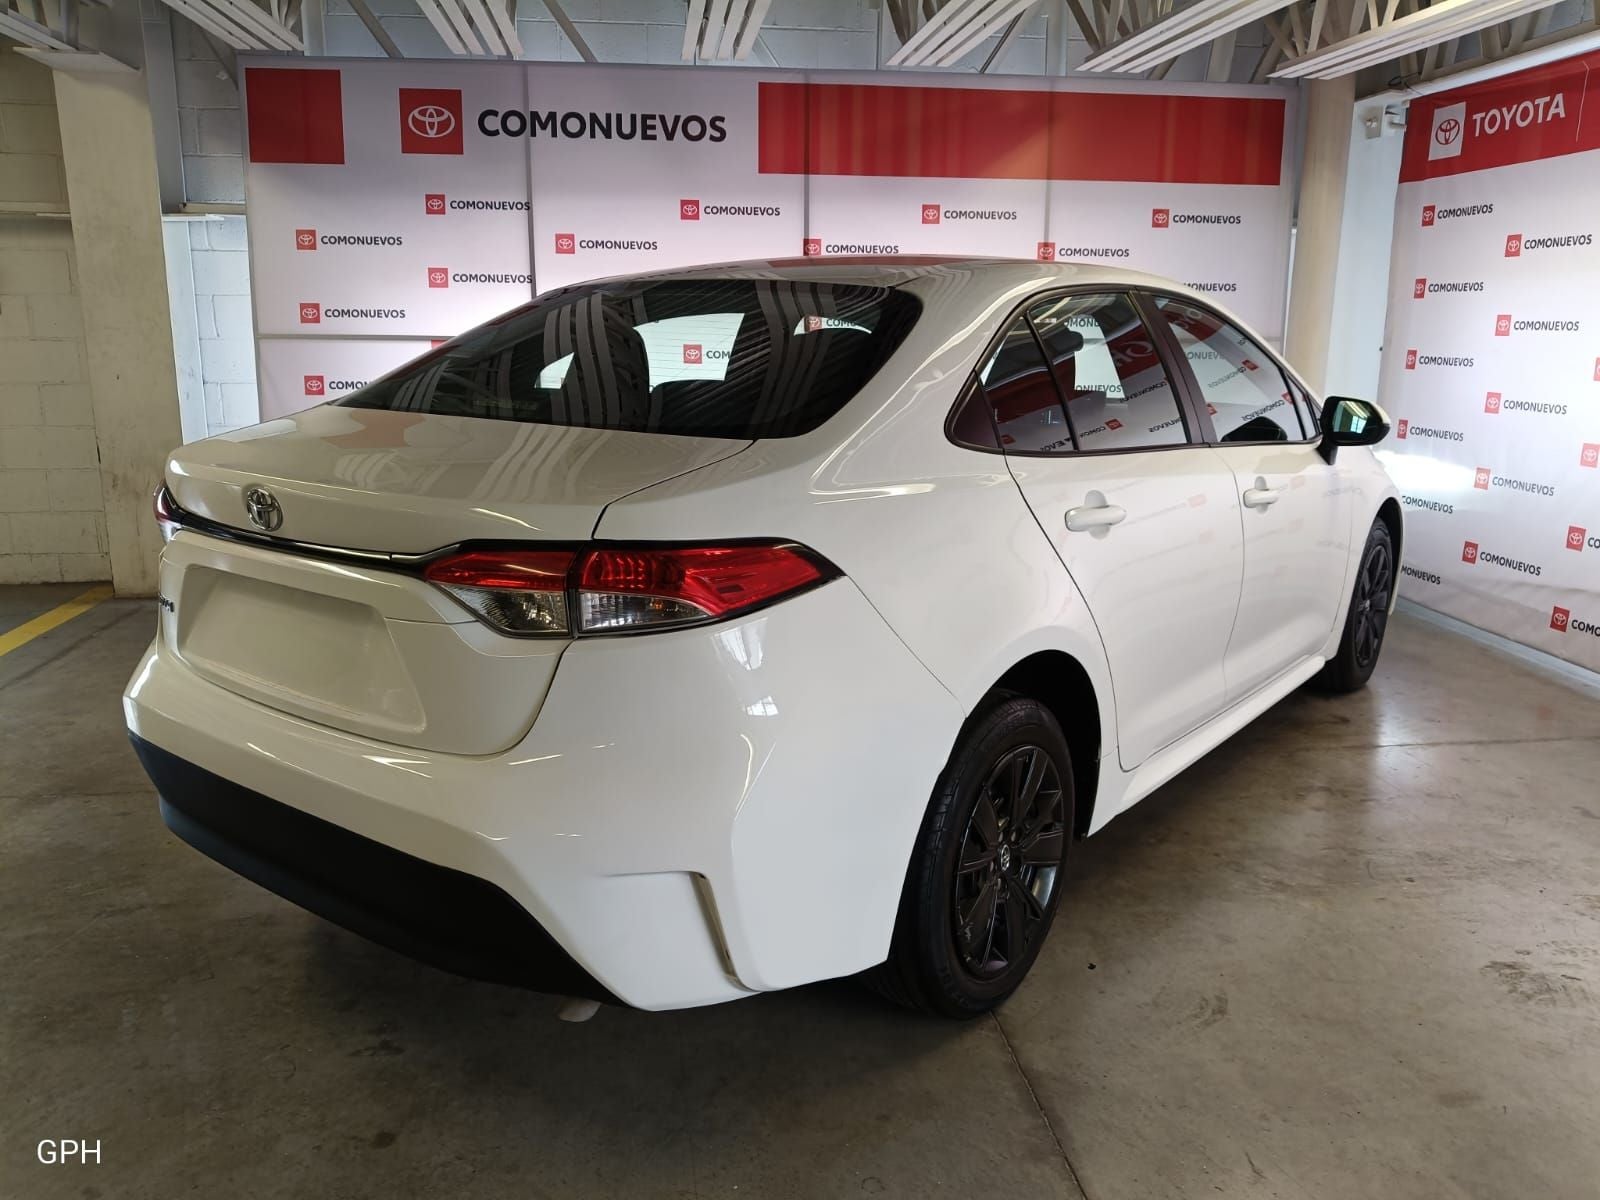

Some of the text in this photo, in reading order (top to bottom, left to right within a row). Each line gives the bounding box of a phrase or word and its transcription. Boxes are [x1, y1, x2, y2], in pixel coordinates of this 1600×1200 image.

[1472, 93, 1566, 137] TOYOTA
[477, 108, 727, 142] COMONUEVOS
[450, 200, 531, 211] COMONUEVOS
[704, 205, 781, 217] COMONUEVOS
[1437, 203, 1494, 220] COMONUEVOS
[944, 209, 1017, 221] COMONUEVOS
[1172, 214, 1241, 225] COMONUEVOS
[321, 235, 403, 246] COMONUEVOS
[579, 239, 658, 251] COMONUEVOS
[1524, 234, 1593, 250] COMONUEVOS
[825, 244, 899, 255] COMONUEVOS
[1059, 248, 1130, 258] COMONUEVOS
[452, 273, 533, 284] COMONUEVOS
[1428, 281, 1484, 293] COMONUEVOS
[324, 308, 406, 319] COMONUEVOS
[1513, 320, 1580, 332] COMONUEVOS
[1418, 355, 1474, 368] COMONUEVOS
[1503, 399, 1568, 415] COMONUEVOS
[1409, 425, 1464, 442] COMONUEVOS
[1492, 475, 1555, 497] COMONUEVOS
[1479, 550, 1542, 577] COMONUEVOS
